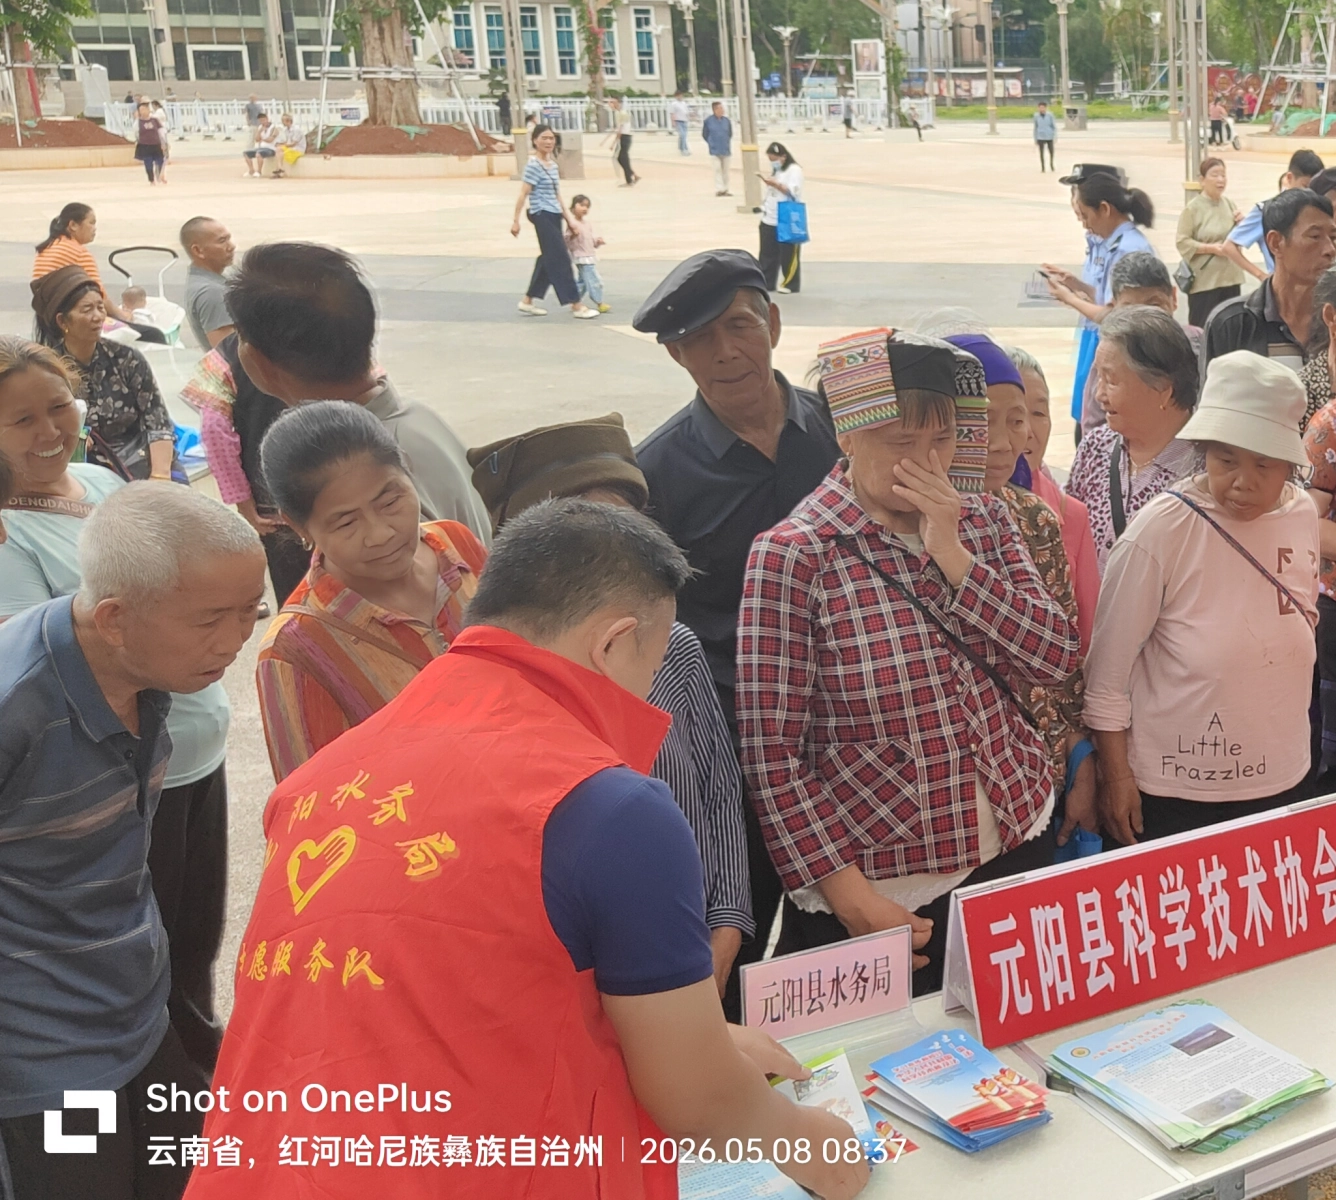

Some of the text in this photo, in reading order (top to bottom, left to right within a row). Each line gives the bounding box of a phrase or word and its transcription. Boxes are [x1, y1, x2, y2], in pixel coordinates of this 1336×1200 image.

[8, 496, 92, 516] DENGDAISH
[1207, 712, 1224, 732] A
[1178, 734, 1242, 757] Little
[1162, 755, 1266, 781] Frazzled
[758, 955, 891, 1028] 元阳县水务局
